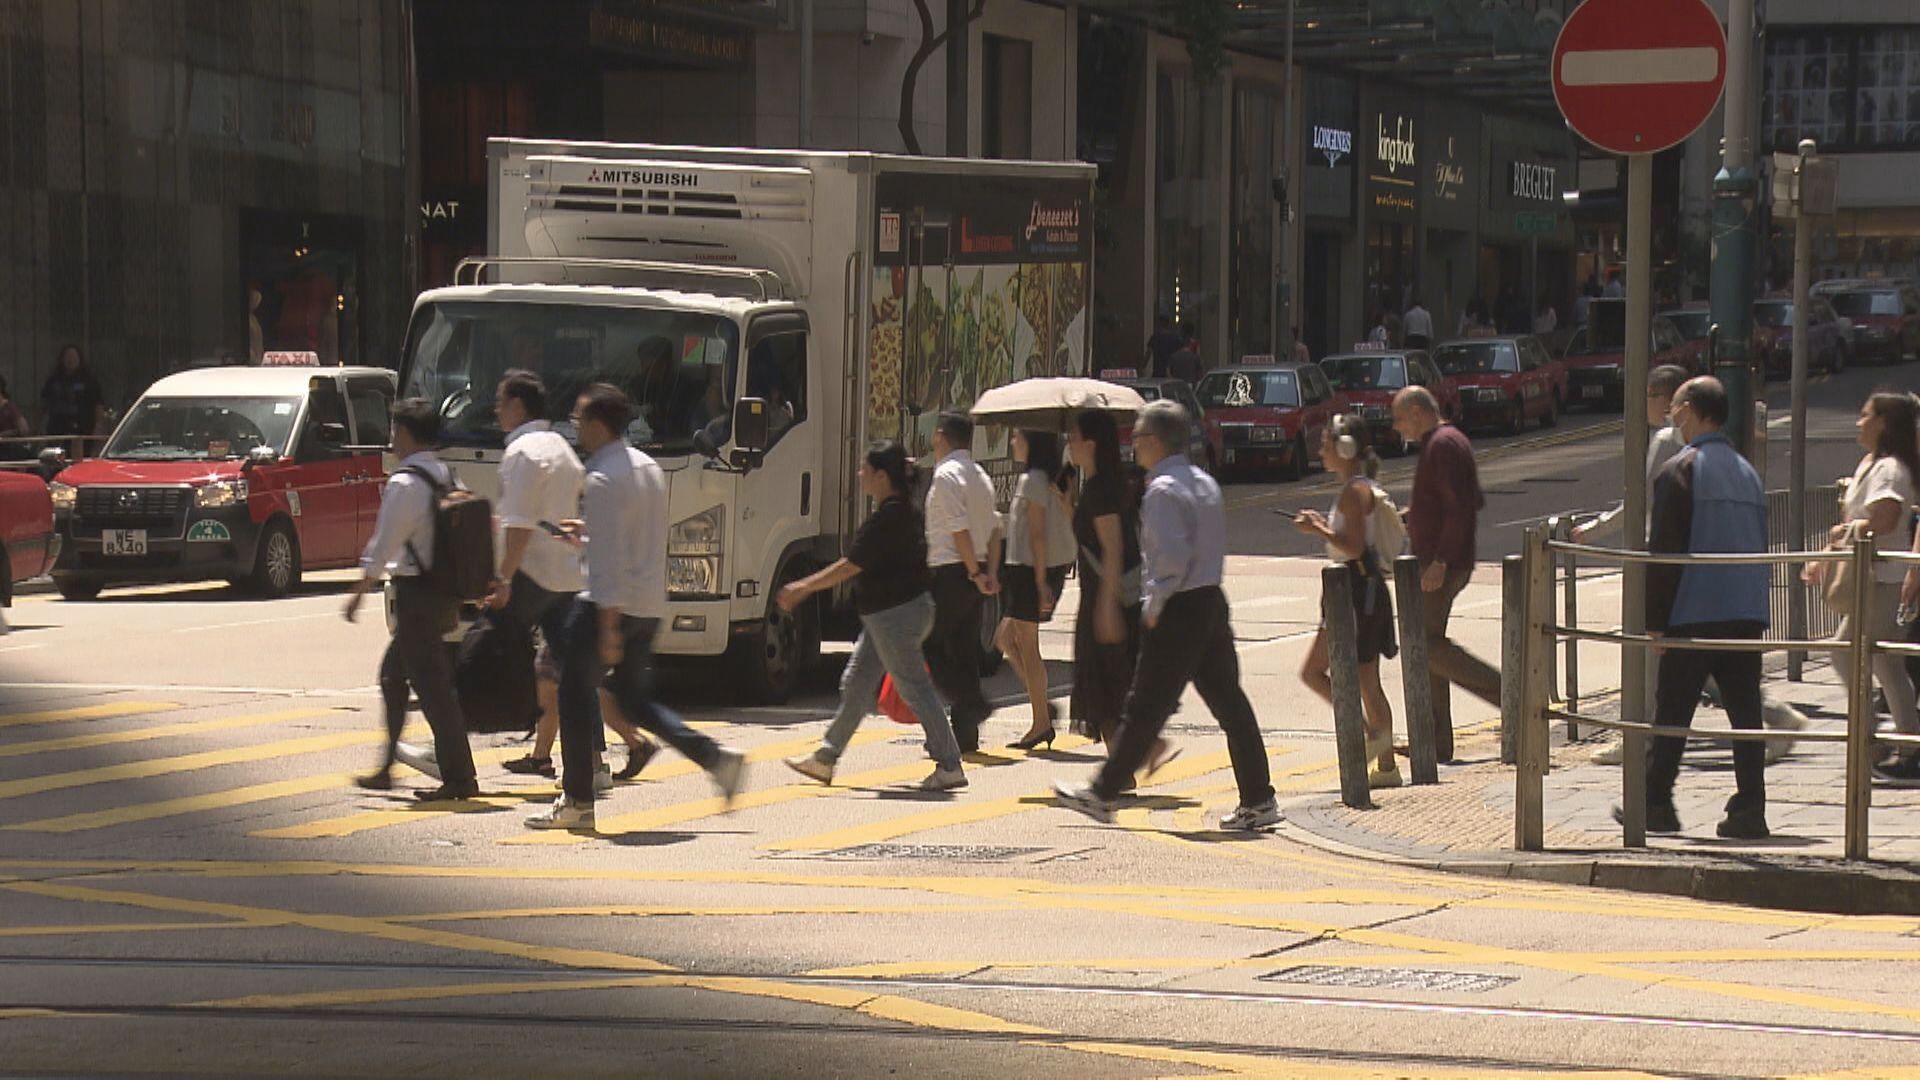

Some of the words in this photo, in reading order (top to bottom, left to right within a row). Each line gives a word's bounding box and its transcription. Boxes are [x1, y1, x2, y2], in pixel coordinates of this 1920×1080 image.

[1313, 125, 1351, 155] LONGINES
[603, 170, 698, 187] MITSUBISHI
[1513, 161, 1556, 201] BREGUET
[266, 352, 310, 364] TAXI
